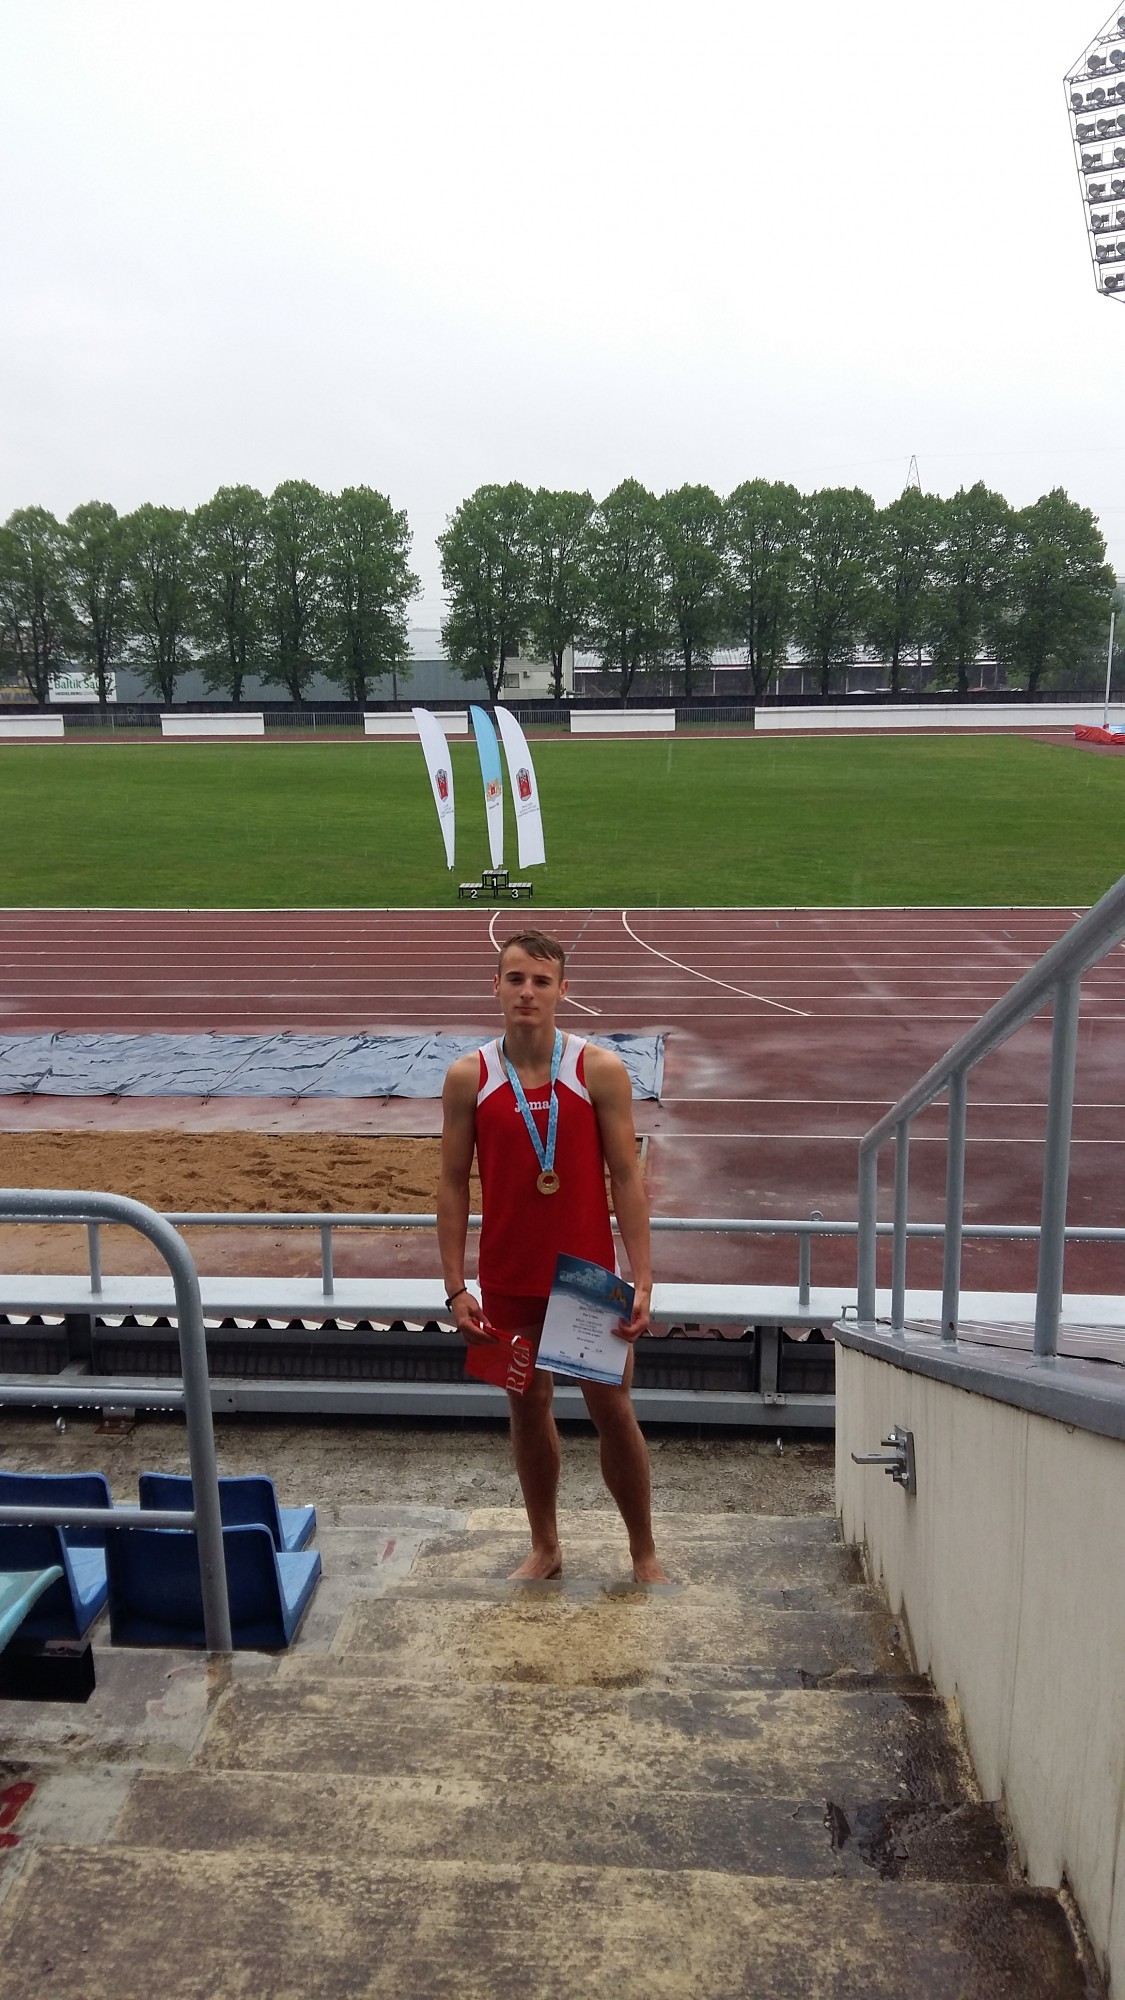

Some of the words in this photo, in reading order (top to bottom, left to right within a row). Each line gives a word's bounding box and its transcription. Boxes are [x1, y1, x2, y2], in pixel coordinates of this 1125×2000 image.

[54, 679, 82, 689] Baltik
[492, 877, 497, 887] 1
[470, 888, 478, 899] 2
[511, 888, 519, 899] 3
